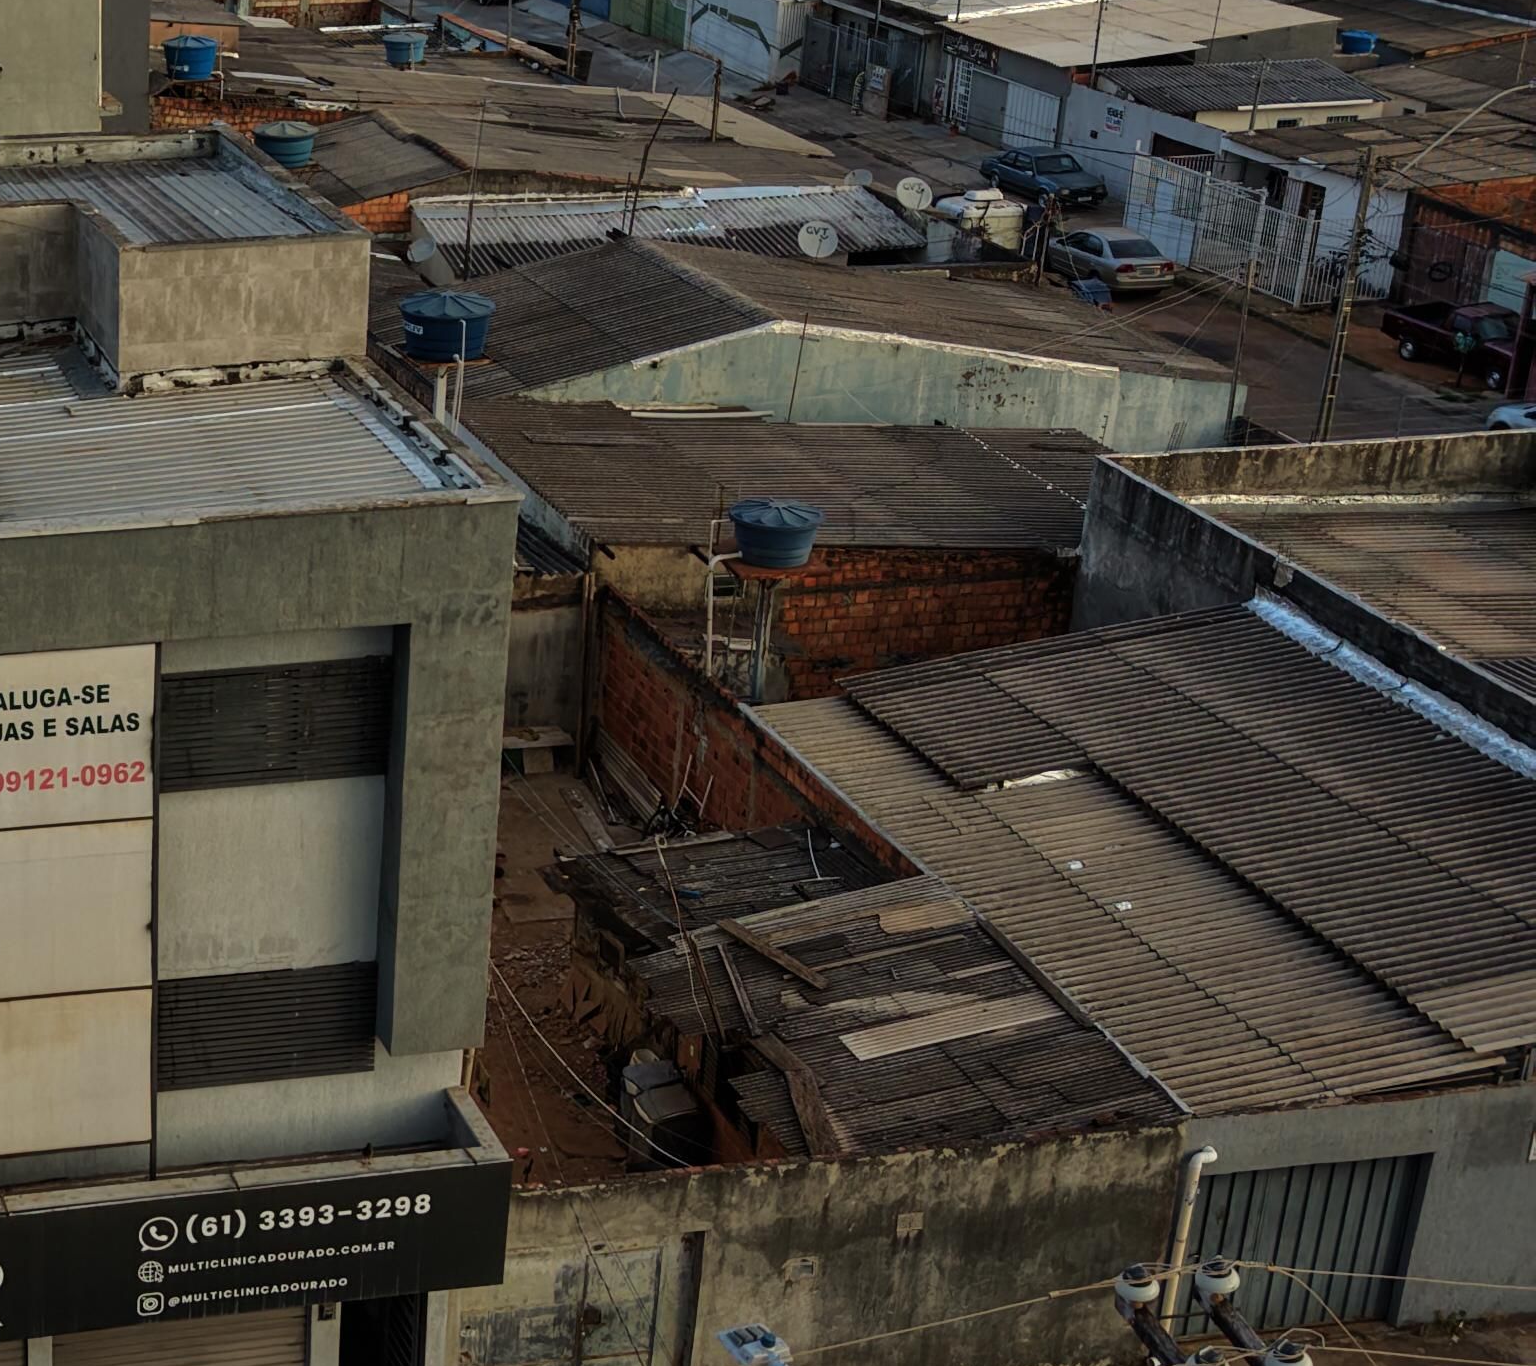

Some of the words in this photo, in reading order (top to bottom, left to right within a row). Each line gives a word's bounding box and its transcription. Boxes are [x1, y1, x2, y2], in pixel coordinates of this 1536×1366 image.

[43, 718, 57, 738] E
[65, 712, 140, 737] SALAS
[185, 1209, 247, 1244] (61)
[259, 1193, 432, 1231] 3393-3298
[168, 1241, 395, 1274] MULTICLINICADOURADO.COM.BR
[168, 1277, 348, 1308] @MULTICLINICADOURADO
